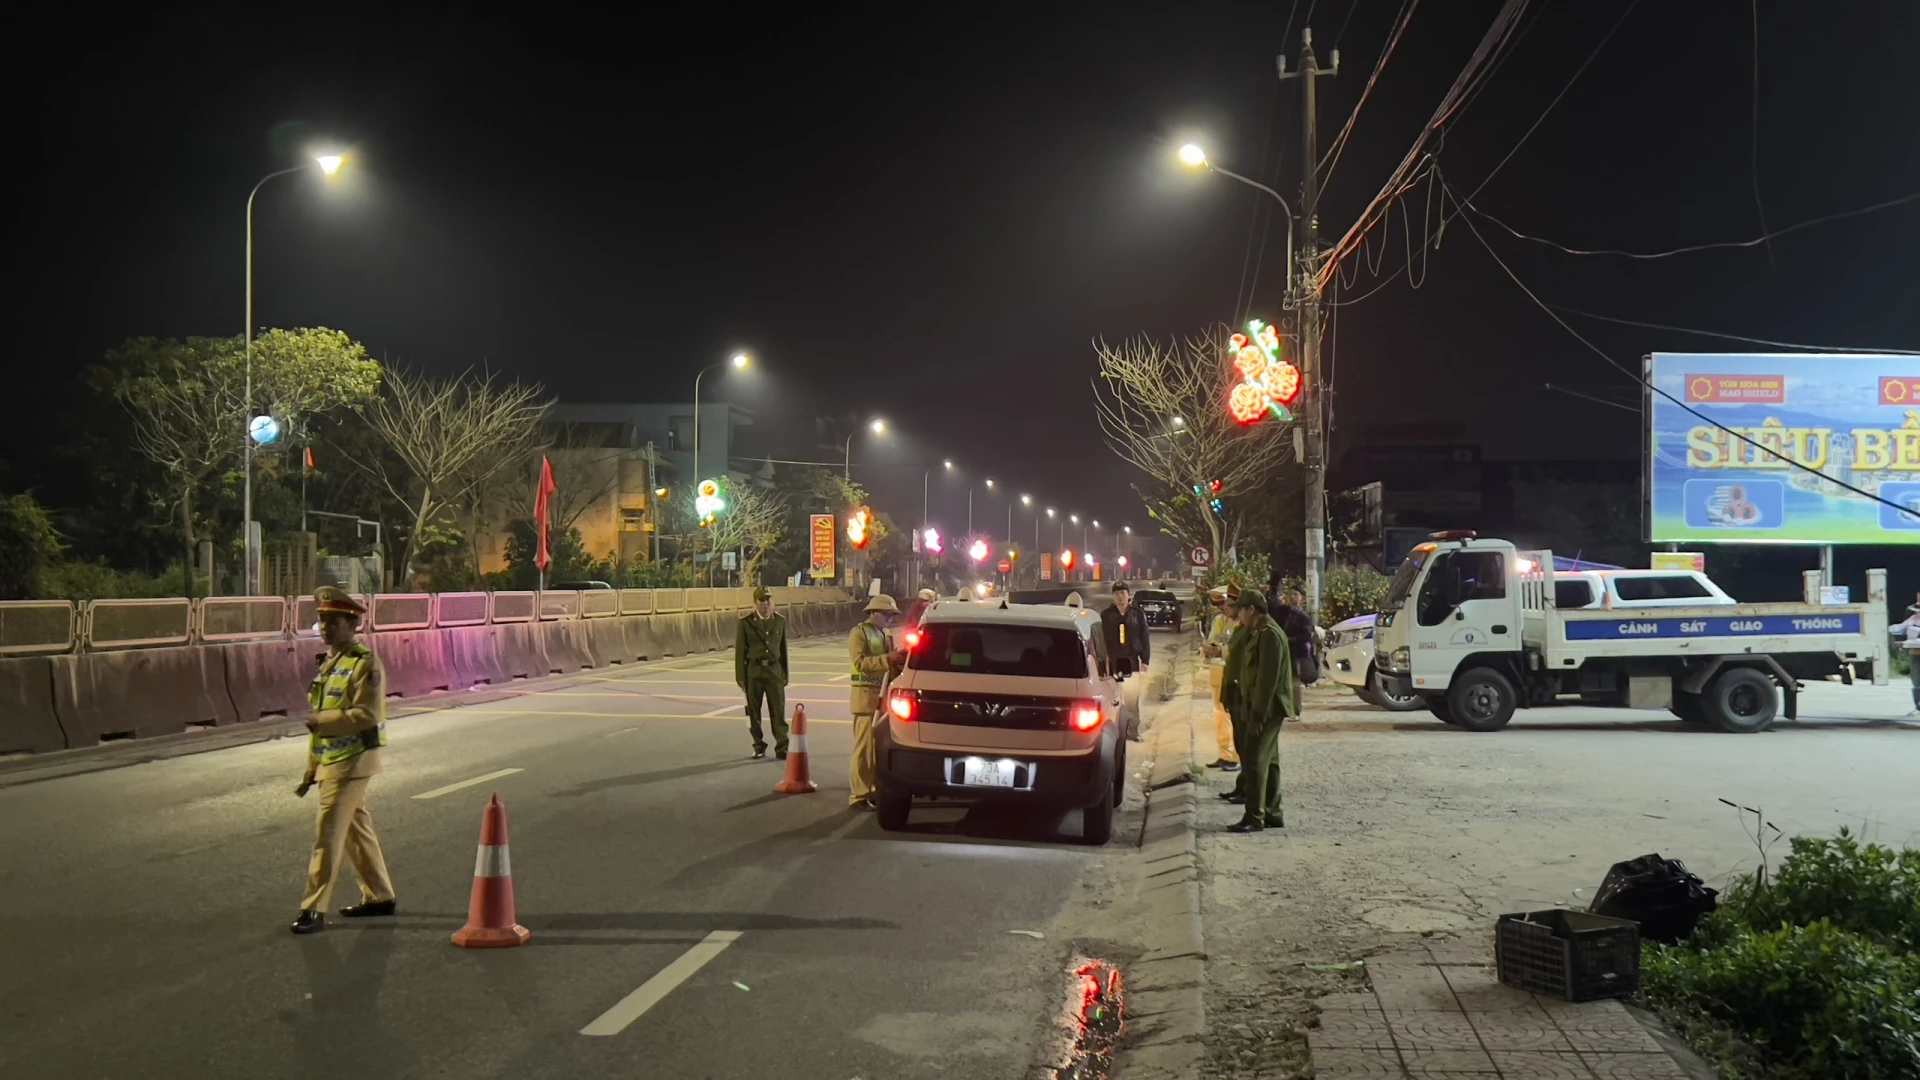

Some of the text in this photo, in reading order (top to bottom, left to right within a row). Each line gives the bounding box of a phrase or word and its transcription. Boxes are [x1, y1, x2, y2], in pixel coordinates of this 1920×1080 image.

[1740, 380, 1759, 388] HOA
[1761, 381, 1779, 389] SEN
[1743, 389, 1779, 397] SHIELD
[1686, 416, 1831, 469] SIÊU
[1618, 618, 1843, 634] CẢNH SÁT GIAO THÔNG
